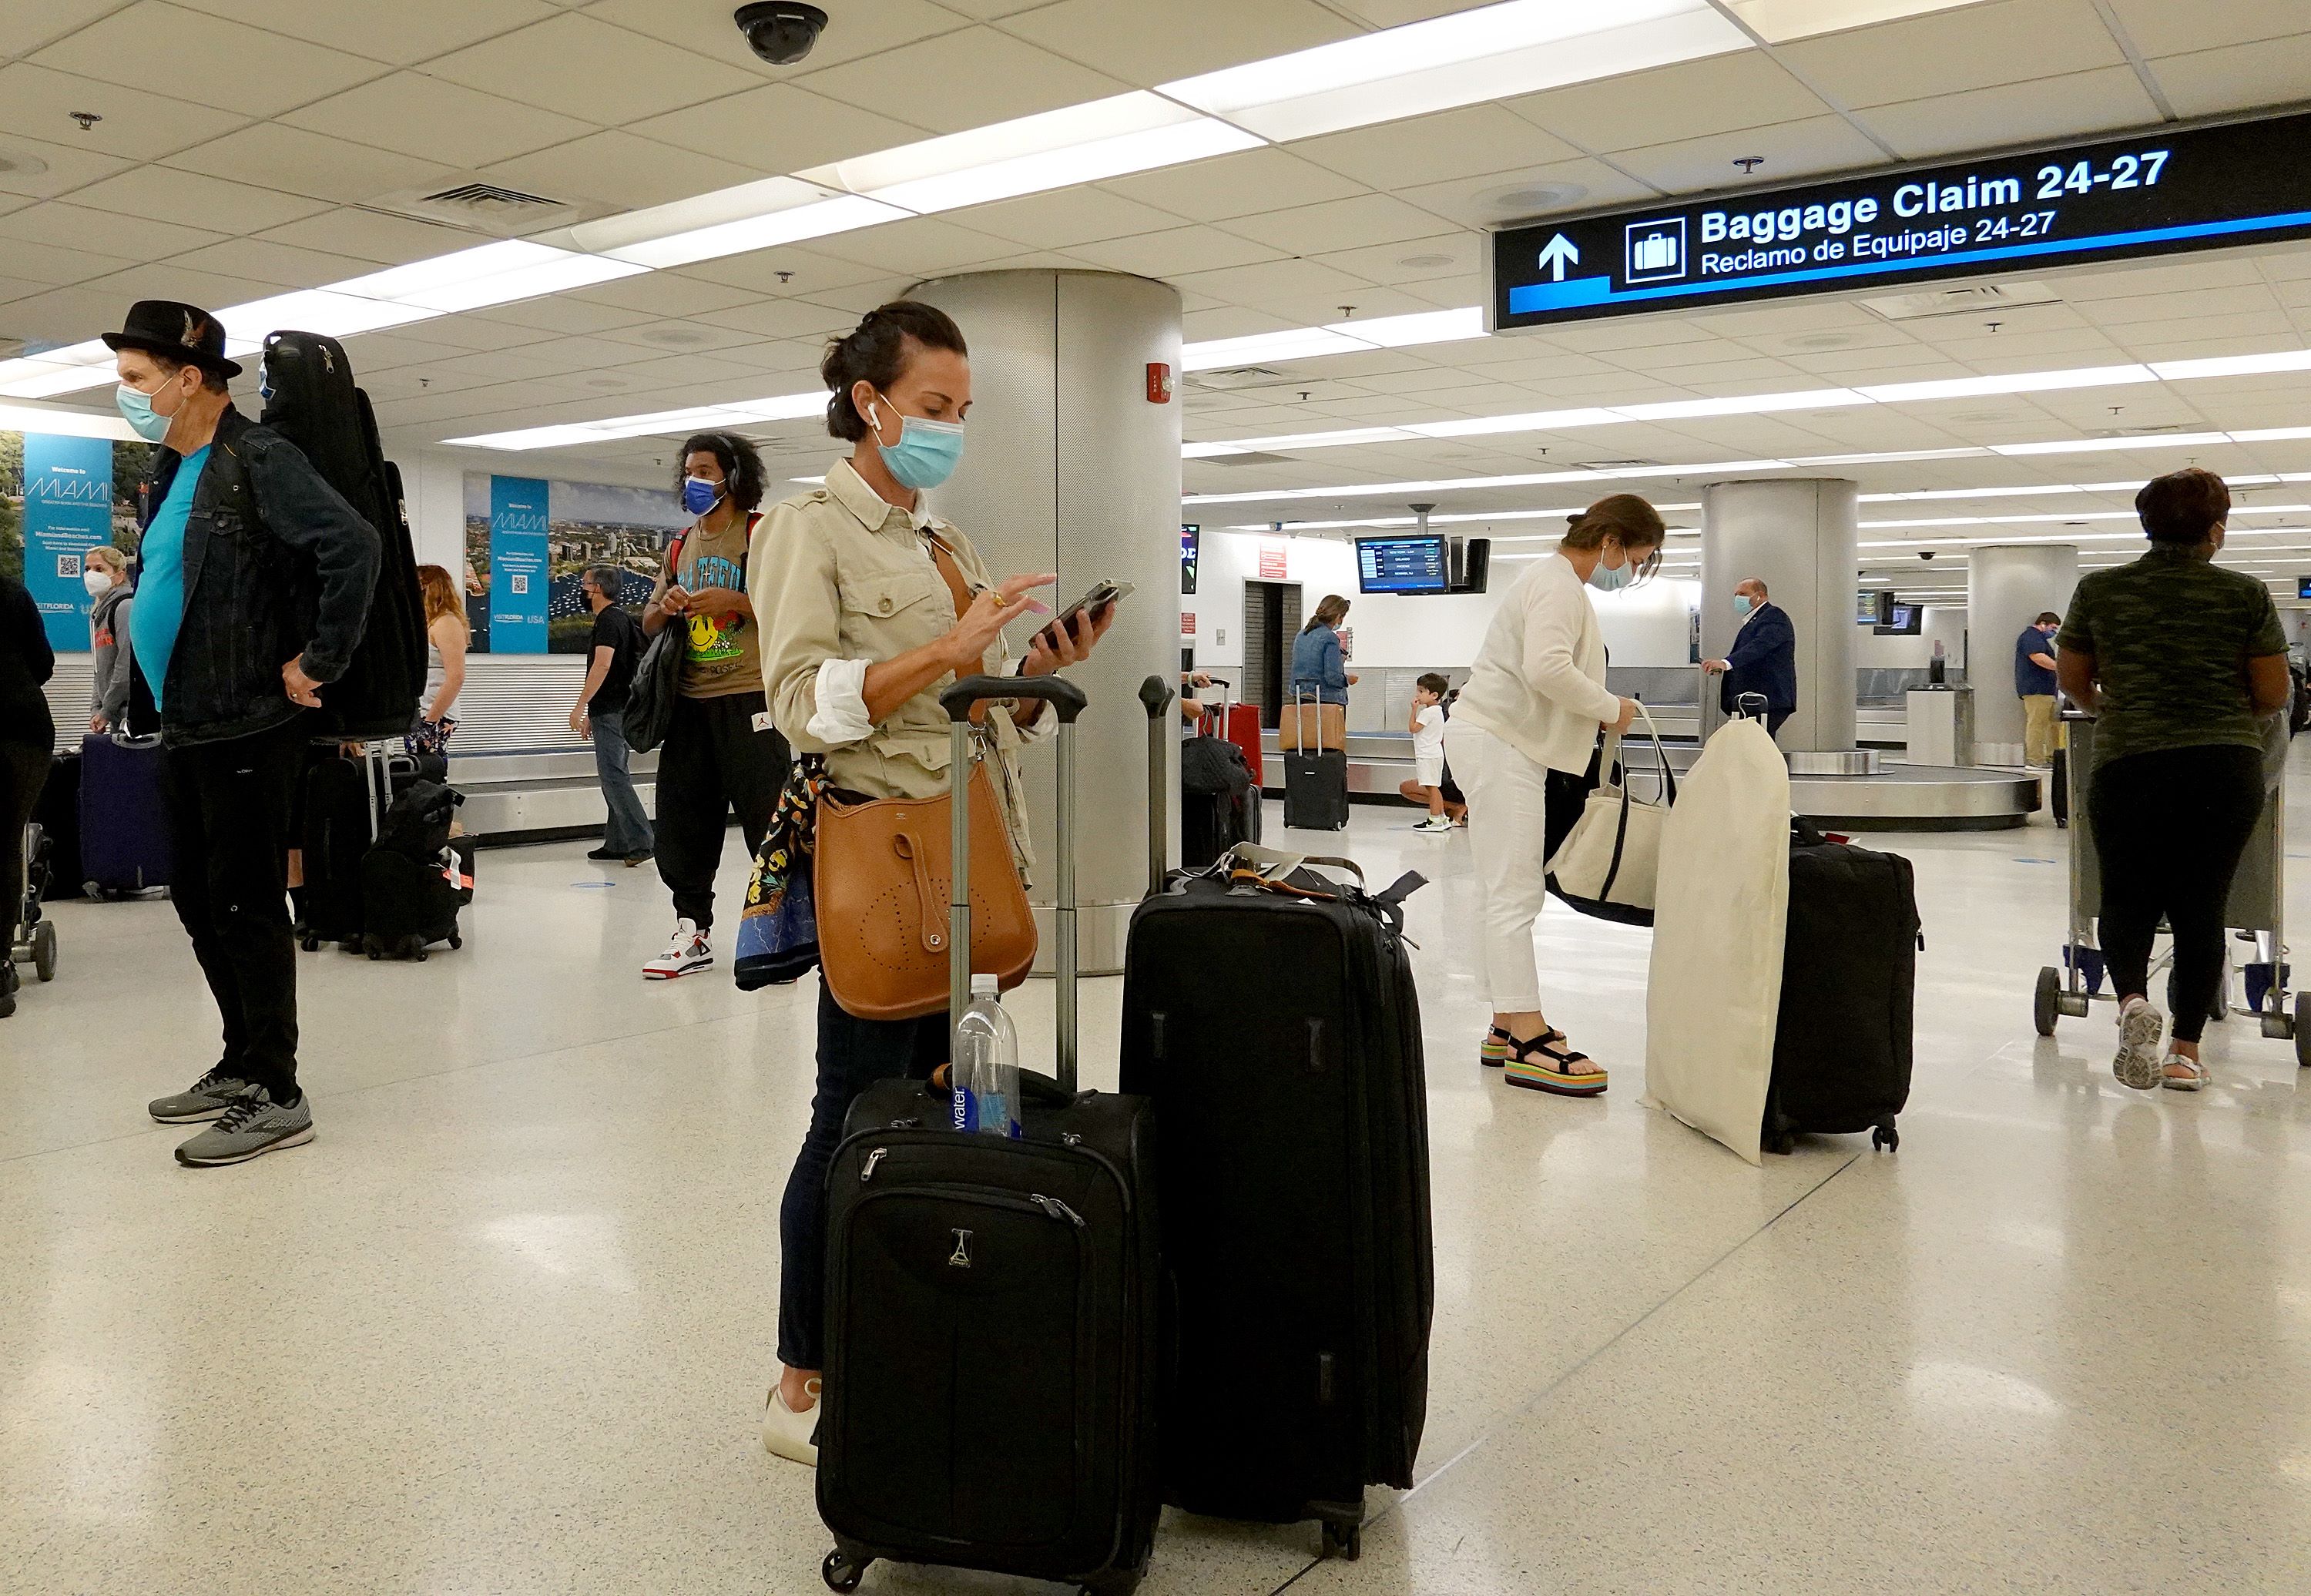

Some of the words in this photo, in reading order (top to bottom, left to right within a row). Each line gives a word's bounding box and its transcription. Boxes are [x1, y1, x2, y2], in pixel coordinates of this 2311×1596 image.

[1702, 198, 1878, 244] Baggage
[1893, 176, 2019, 217] Claim
[2036, 150, 2168, 200] 24-27
[1702, 247, 1806, 275] Reclamo
[1813, 239, 1844, 261] de
[1853, 227, 1967, 259] Equipaje
[1975, 211, 2055, 242] 24-27
[27, 477, 108, 501] MIAMI
[492, 511, 547, 531] MIAMI
[527, 615, 545, 624] USA
